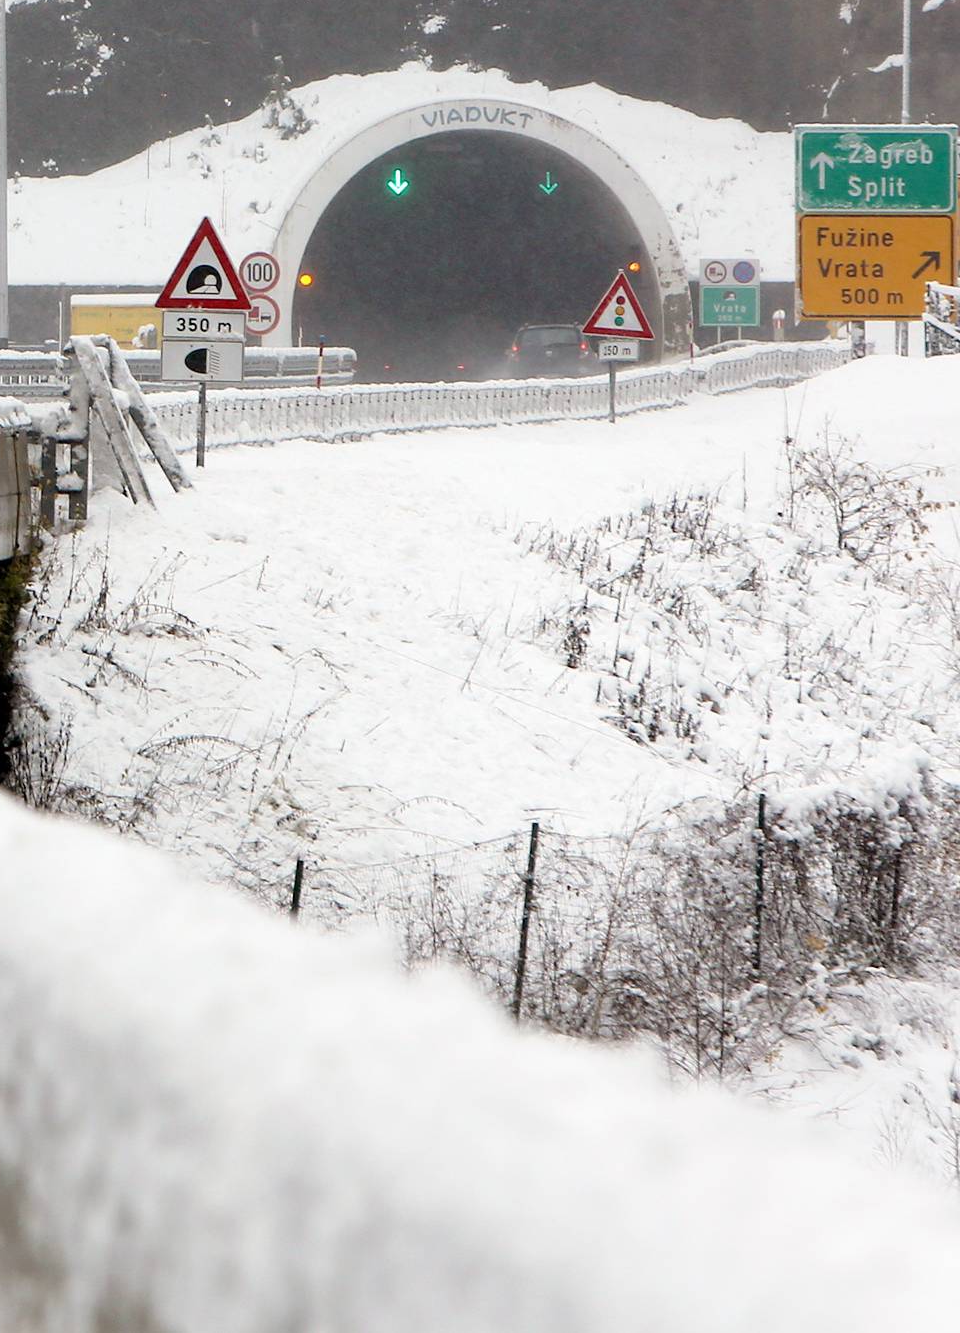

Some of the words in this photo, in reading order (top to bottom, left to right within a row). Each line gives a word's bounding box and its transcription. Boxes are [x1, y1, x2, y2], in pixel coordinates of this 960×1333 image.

[421, 106, 533, 128] VIADUKT
[847, 144, 933, 169] Zagreb
[847, 175, 906, 201] Split
[816, 227, 894, 247] Fužine
[246, 262, 273, 282] 100
[818, 259, 884, 278] Vrata
[841, 289, 879, 304] 500
[887, 292, 904, 304] m
[713, 303, 747, 313] Vrata
[176, 318, 210, 332] 350
[217, 323, 232, 333] m
[603, 345, 618, 356] 150
[623, 347, 632, 355] m
